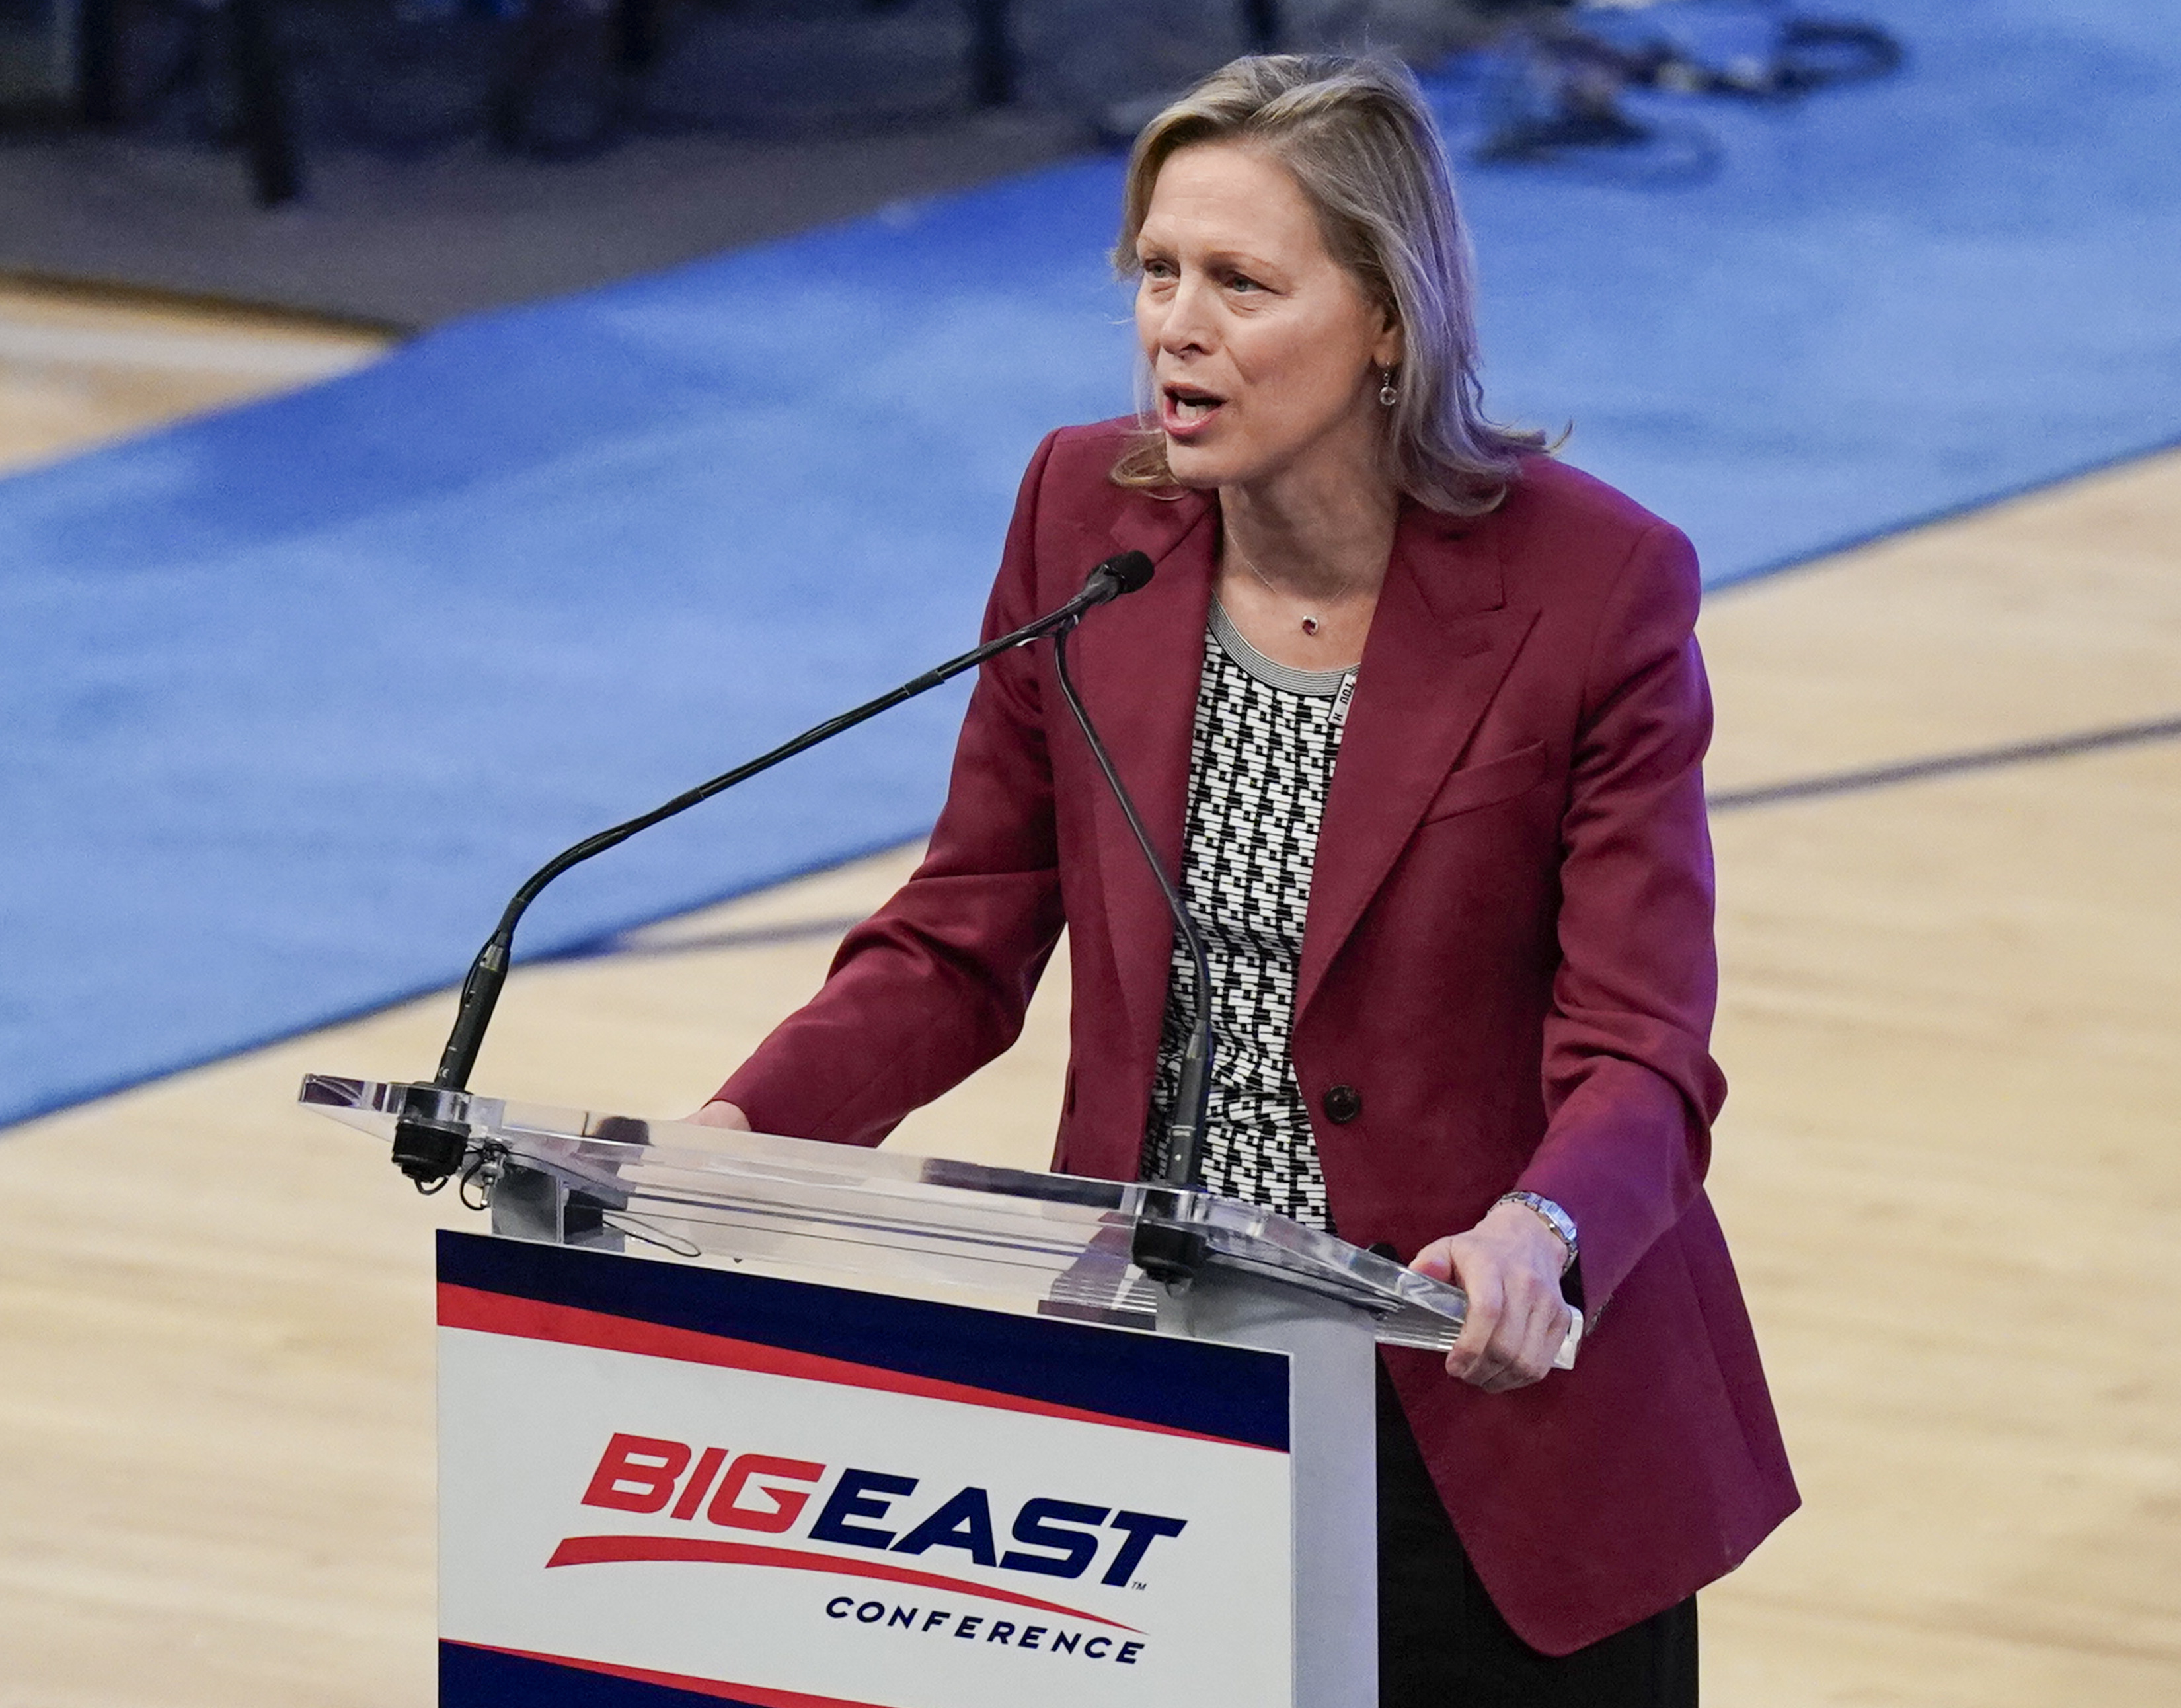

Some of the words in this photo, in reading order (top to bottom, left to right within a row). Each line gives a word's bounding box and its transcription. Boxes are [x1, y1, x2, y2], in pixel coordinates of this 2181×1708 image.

[580, 1432, 826, 1533] BIG
[807, 1467, 1188, 1588] EAST
[826, 1596, 1145, 1664] CONFERENCE
